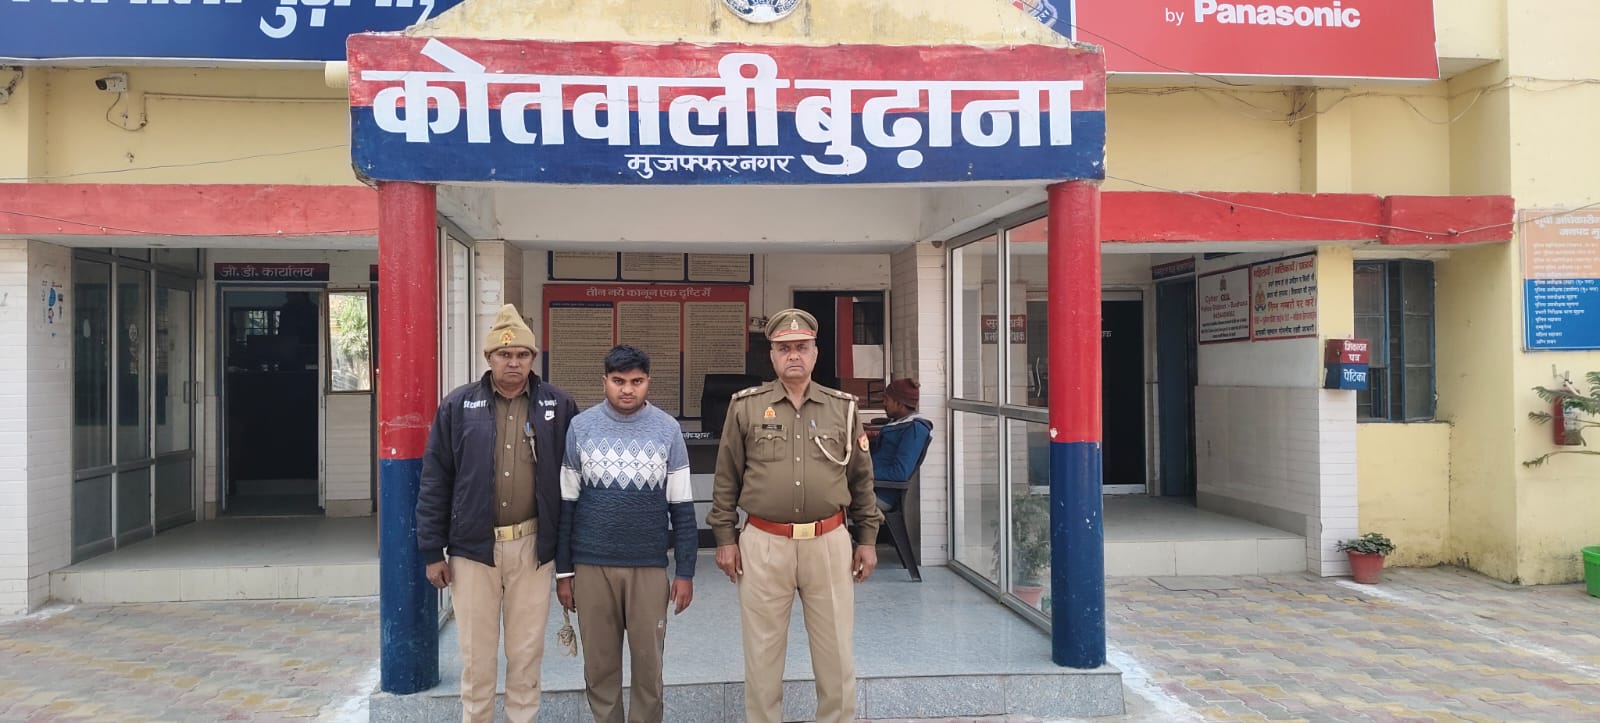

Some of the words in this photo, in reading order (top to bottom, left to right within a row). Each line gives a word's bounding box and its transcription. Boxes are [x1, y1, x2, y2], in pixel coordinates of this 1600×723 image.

[1165, 7, 1184, 26] by
[1194, 0, 1361, 28] Panasonic
[361, 38, 791, 147] कोतवाली
[794, 79, 1084, 175] बुढ़ाना
[262, 265, 315, 278] कार्यालय
[586, 286, 606, 297] तीन
[627, 287, 658, 300] कानून
[660, 288, 677, 298] एक
[1348, 353, 1361, 362] पत्र
[1343, 368, 1367, 383] पेटिका
